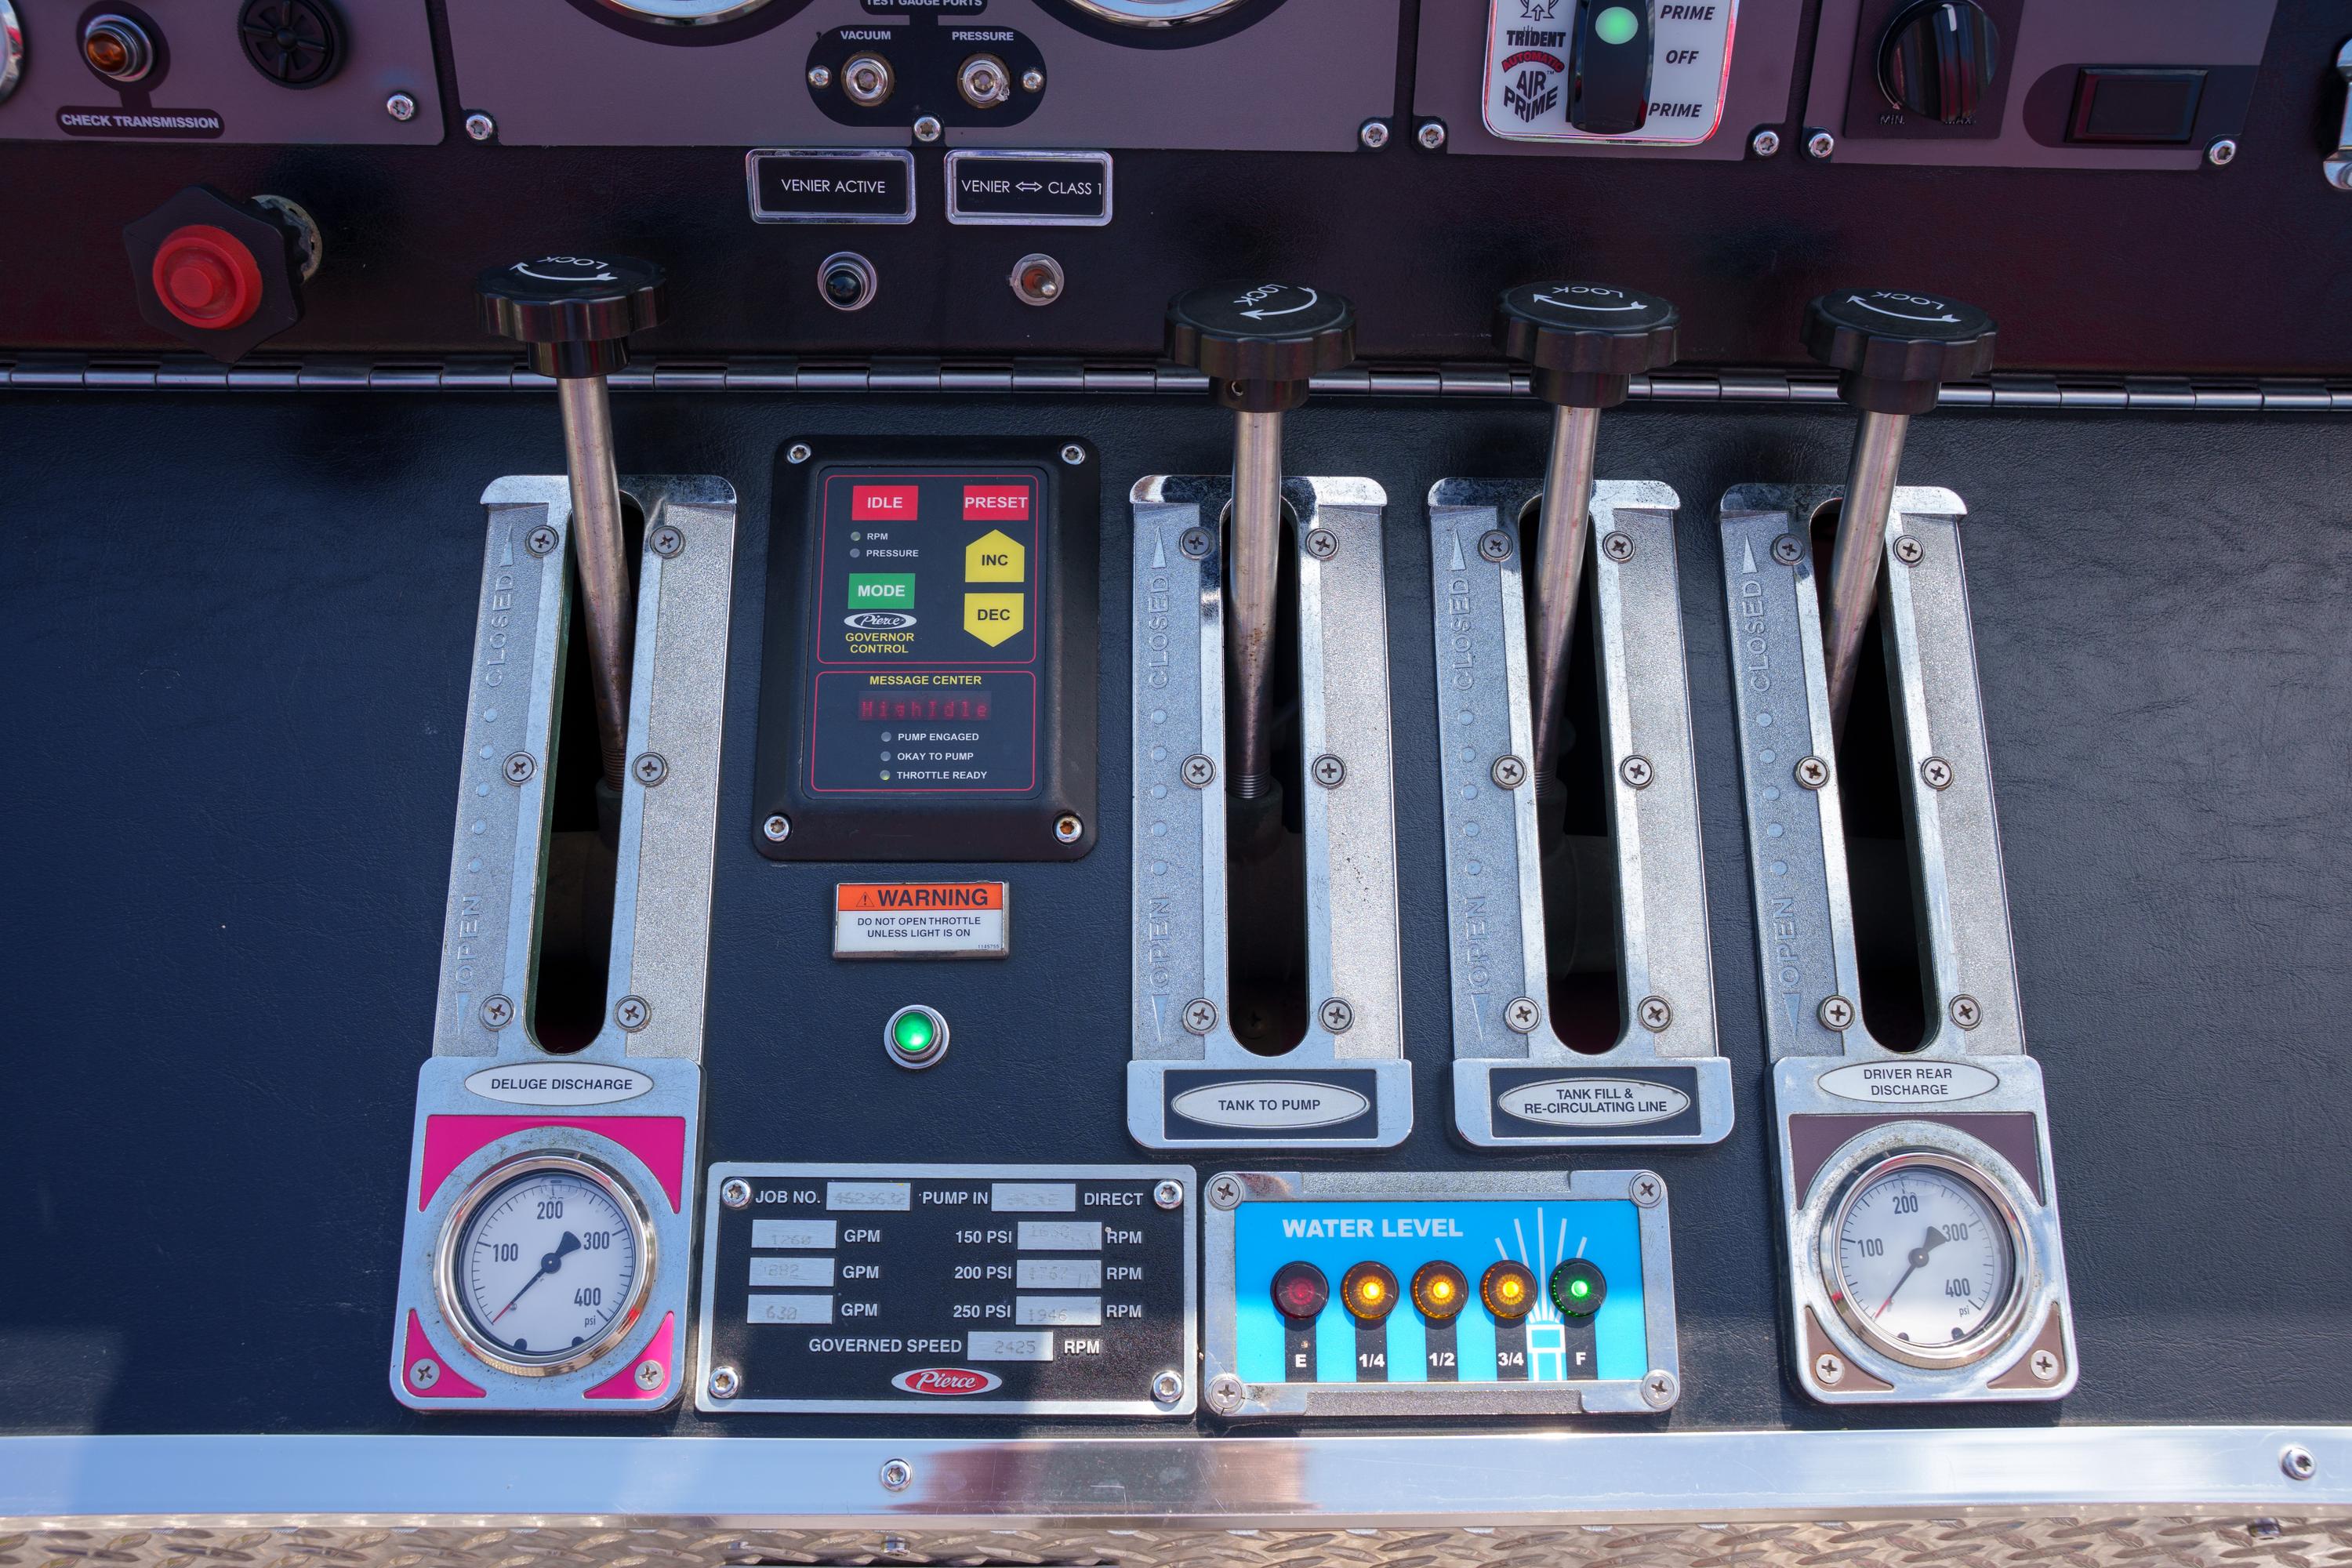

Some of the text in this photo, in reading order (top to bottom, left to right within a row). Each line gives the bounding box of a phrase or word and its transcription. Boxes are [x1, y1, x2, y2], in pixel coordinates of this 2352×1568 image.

[1661, 5, 1715, 20] PRIME
[840, 31, 891, 40] VACUUM
[952, 31, 1014, 41] PRESSURE
[1507, 27, 1566, 47] TRIDENT
[1501, 50, 1565, 73] AUTOMATIC
[1666, 50, 1699, 64] OFF
[1516, 71, 1546, 100] AIR
[1504, 85, 1559, 123] PRIME
[1649, 103, 1702, 118] PRIME
[61, 114, 219, 129] CHECK TRANSMISSION
[782, 180, 885, 193] VENIER ACTIVE
[962, 180, 1010, 193] VENIER
[1048, 181, 1091, 194] CLASS
[536, 256, 609, 270] LOCK
[1233, 284, 1288, 307] LOCK
[1552, 286, 1623, 299] LOCK
[1871, 291, 1945, 310] LOCK
[867, 497, 903, 509] IDLE
[964, 496, 1029, 509] PRESET
[982, 554, 1008, 566] INC
[858, 585, 906, 597] MODE
[860, 614, 901, 626] Pierce
[977, 609, 1011, 621] DEC
[486, 575, 514, 687] CLOSED
[845, 633, 914, 642] GOVERNOR
[1149, 575, 1169, 690] CLOSED
[1450, 577, 1474, 691] CLOSED
[1742, 580, 1770, 692] CLOSED
[850, 644, 909, 654] CONTROL
[869, 676, 982, 685] MESSAGE CENTER
[877, 888, 988, 907] WARNING
[875, 917, 895, 926] NOT
[898, 917, 927, 926] OPEN
[930, 916, 981, 925] THROTTLE
[456, 895, 482, 985] OPEN
[910, 929, 940, 938] LIGHT
[1465, 896, 1490, 986] OPEN
[1149, 898, 1170, 988] OPEN
[1771, 898, 1800, 986] OPEN
[1864, 1069, 1952, 1080] DRIVER REAR
[491, 1079, 633, 1090] DELUGE DISCHARGE
[1871, 1085, 1948, 1095] DISCHARGE
[1556, 1088, 1633, 1099] TANK FILL &
[1218, 1099, 1320, 1110] TANK TO PUMP
[1524, 1102, 1667, 1113] RE-CIRCULATING LINE
[755, 1190, 788, 1203] JOB
[793, 1190, 821, 1203] NO.
[922, 1192, 968, 1204] PUMP
[973, 1192, 989, 1204] IN
[1084, 1192, 1144, 1206] DIRECT
[1893, 1195, 1918, 1214] 200
[537, 1201, 564, 1220] 200
[1282, 1218, 1464, 1238] WATER LEVEL
[1942, 1223, 1969, 1242] 300
[583, 1231, 610, 1250] 300
[844, 1229, 881, 1243] GPM
[956, 1231, 982, 1243] 150
[987, 1231, 1012, 1243] PSI
[1107, 1231, 1142, 1244] RPM
[492, 1243, 518, 1262] 100
[1857, 1238, 1884, 1258] 100
[842, 1265, 880, 1279] GPM
[955, 1267, 982, 1279] 200
[986, 1267, 1011, 1279] PSI
[1107, 1268, 1142, 1280] RPM
[1945, 1278, 1970, 1297] 400
[574, 1287, 601, 1306] 400
[840, 1303, 878, 1316] GPM
[953, 1305, 1142, 1322] 250 PSI 1946 RPM
[1959, 1305, 1969, 1317] psi
[584, 1316, 596, 1327] psi
[809, 1338, 1100, 1354] GOVERNED SPEED 2425 RPM
[1295, 1353, 1307, 1368] E
[1359, 1352, 1385, 1369] 1/4
[1428, 1352, 1455, 1368] 1/2
[1497, 1352, 1524, 1367] 3/4
[1576, 1352, 1586, 1367] F
[916, 1370, 977, 1390] Pierce
